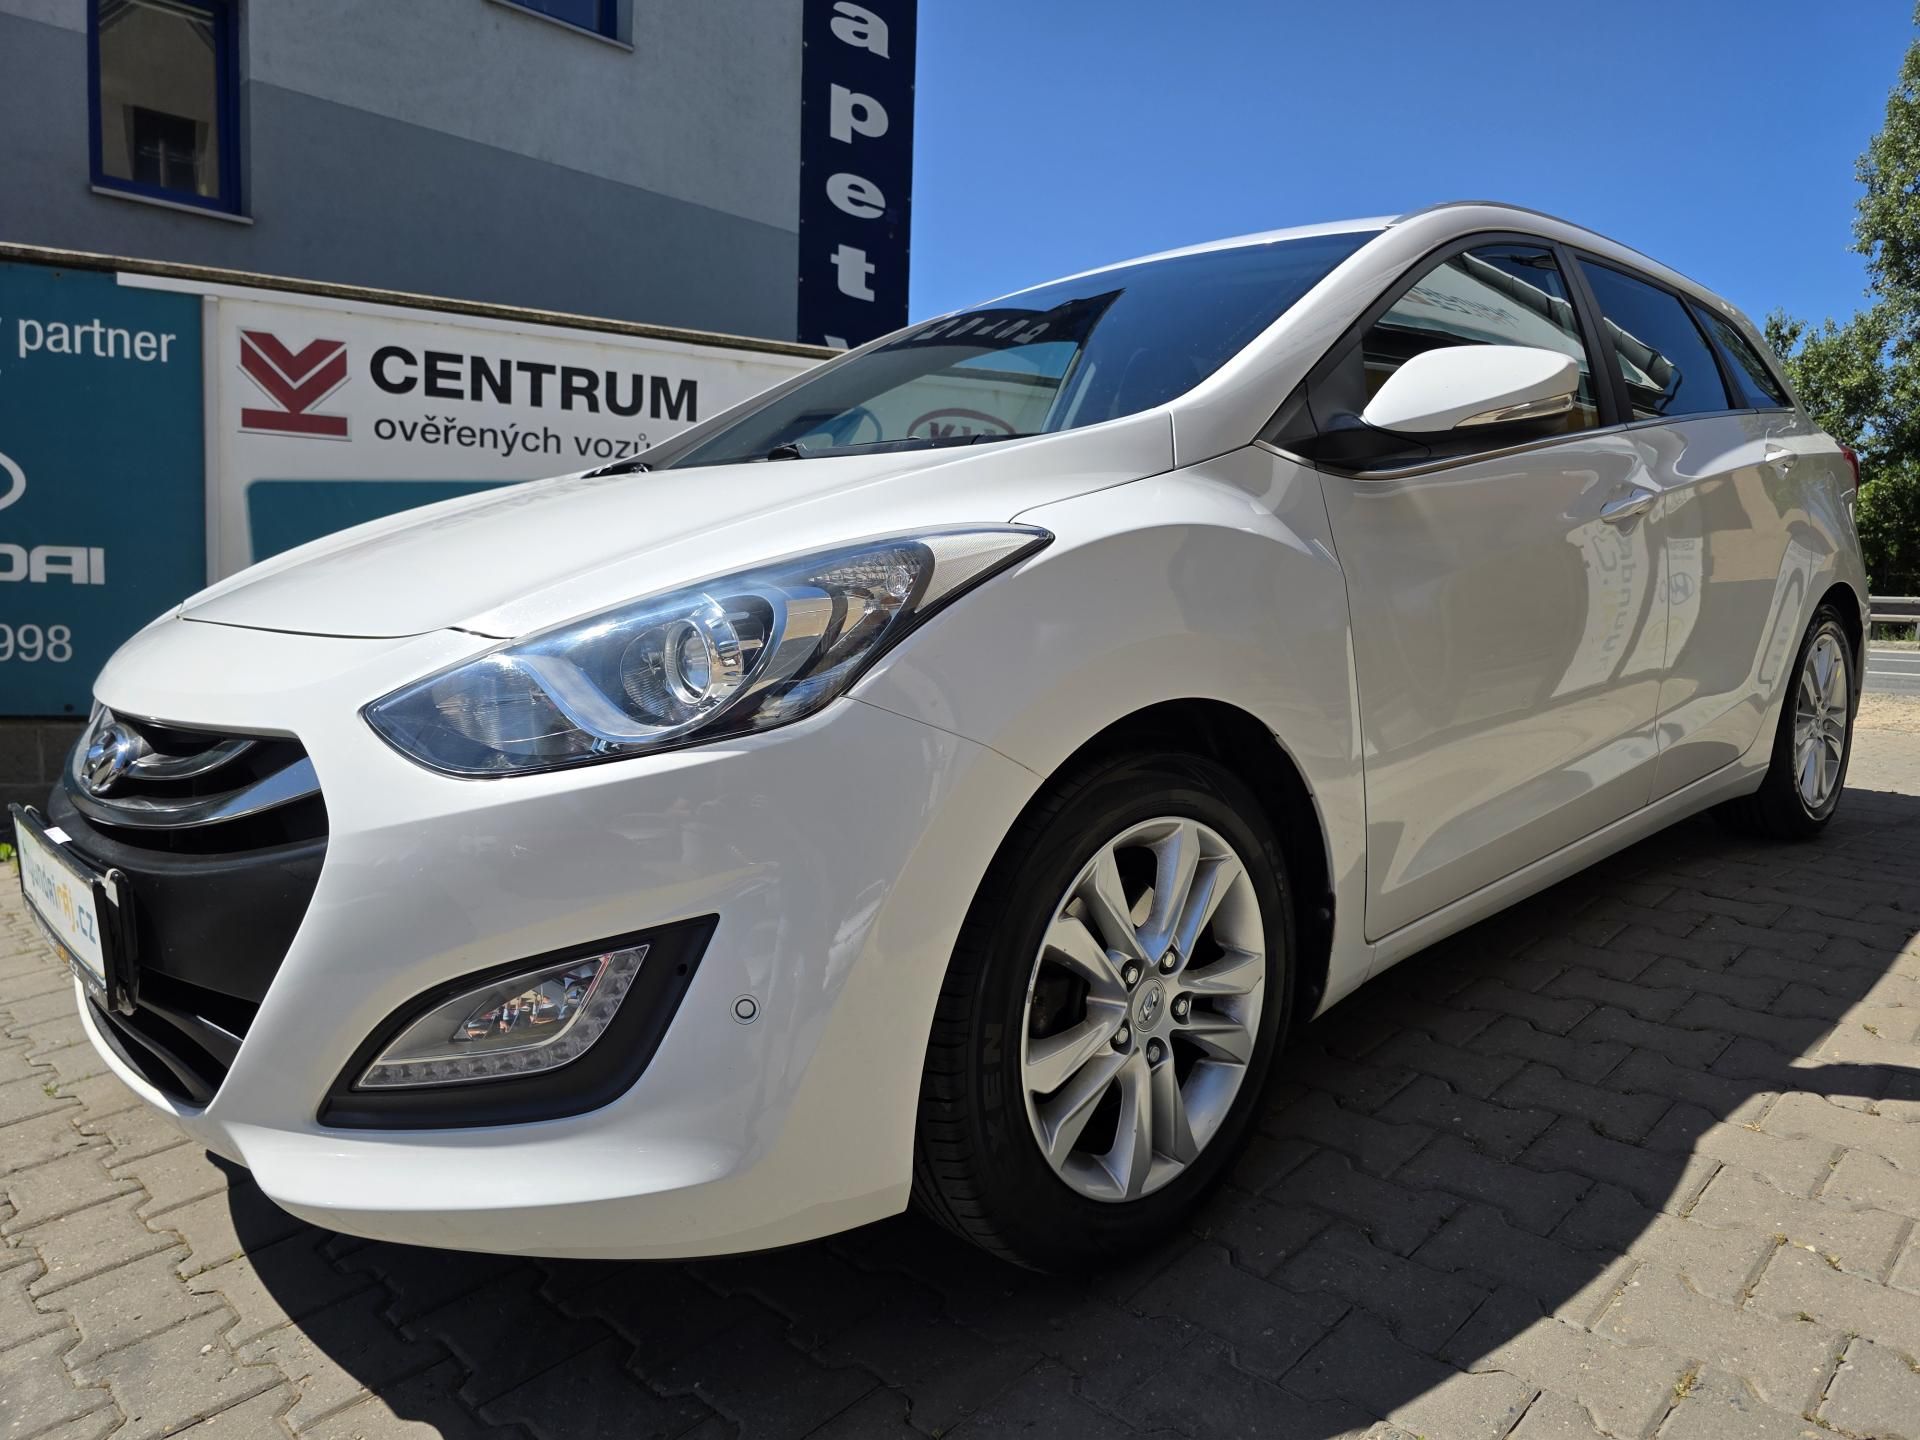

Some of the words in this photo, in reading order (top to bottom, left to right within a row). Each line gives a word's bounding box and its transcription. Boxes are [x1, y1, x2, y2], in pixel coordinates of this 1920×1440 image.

[824, 0, 890, 350] apet
[19, 319, 176, 362] partner
[370, 345, 697, 422] CENTRUM
[374, 414, 561, 457] ověřených
